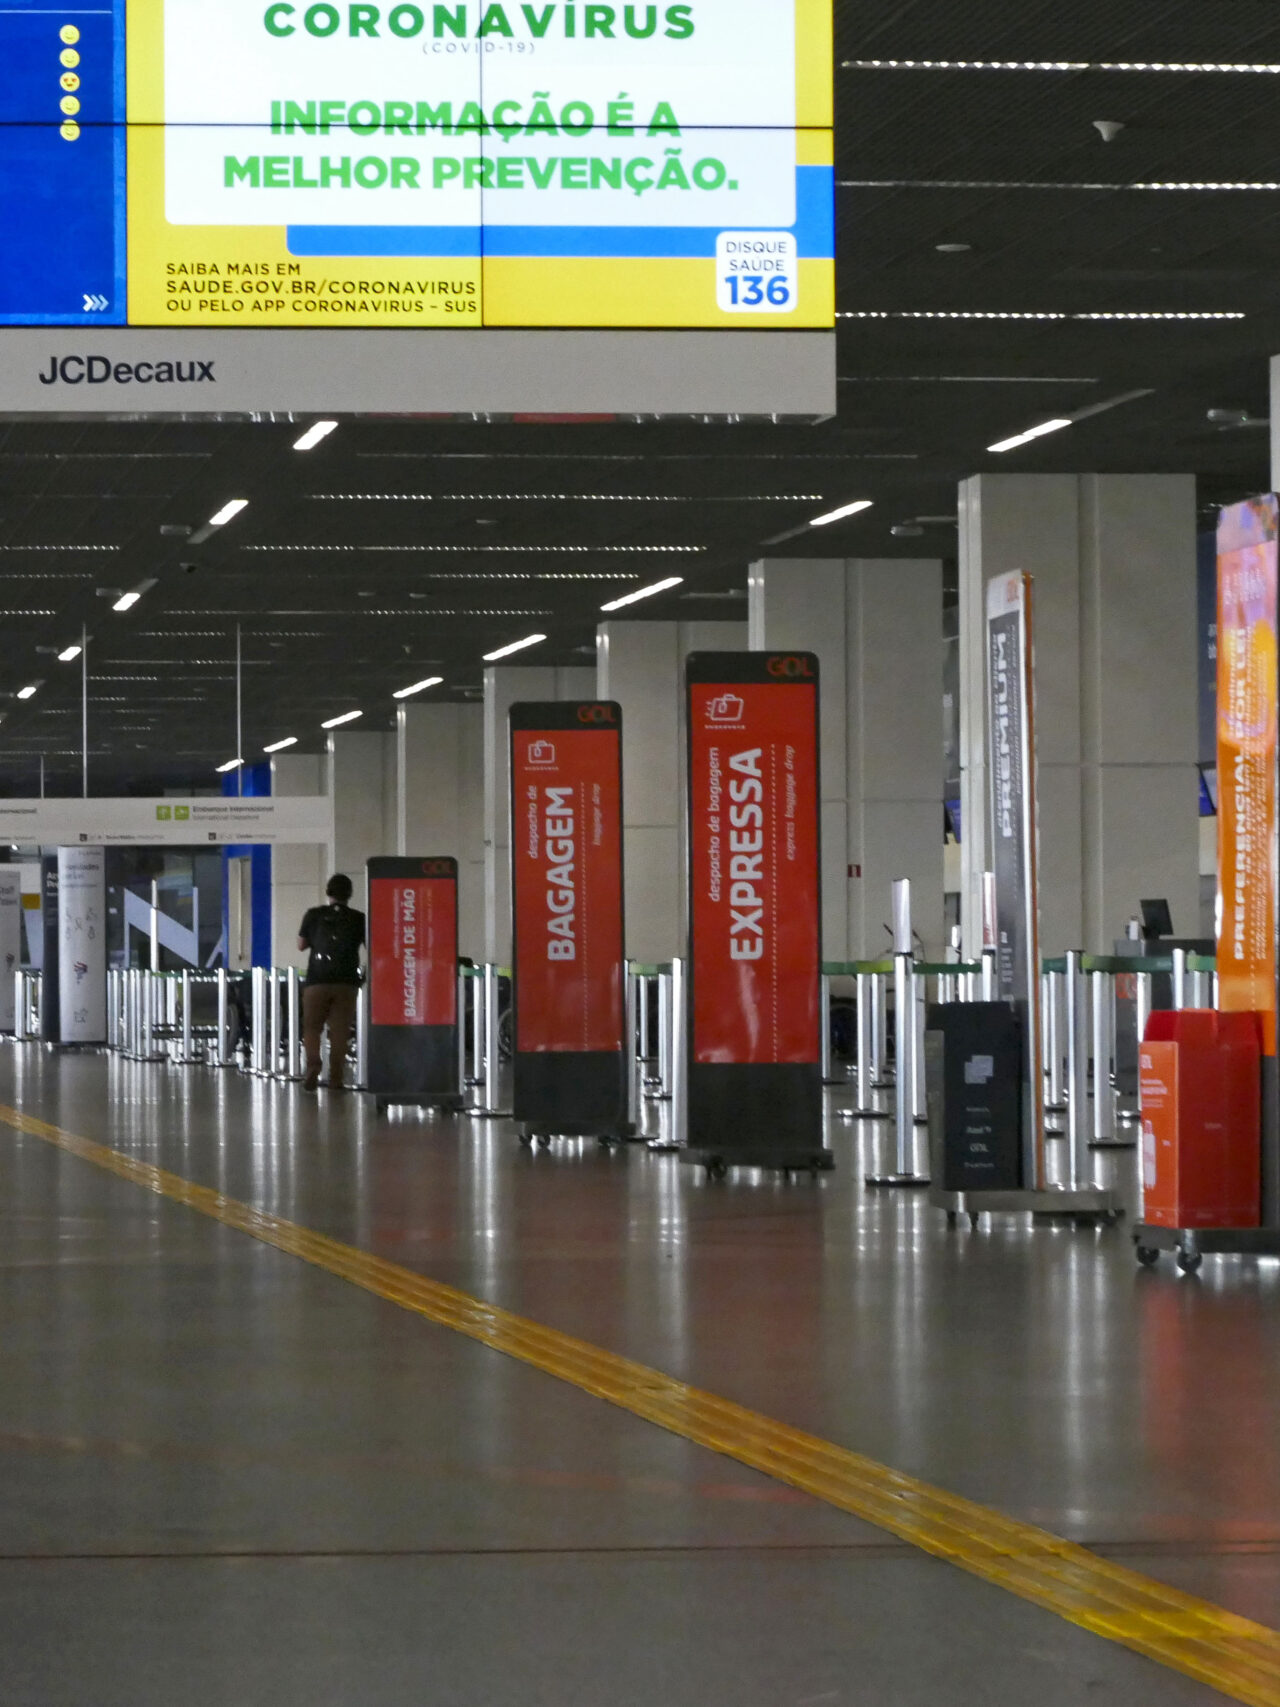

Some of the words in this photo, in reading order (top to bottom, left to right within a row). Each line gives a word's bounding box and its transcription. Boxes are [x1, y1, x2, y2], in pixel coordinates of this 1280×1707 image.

[263, 0, 696, 39] CORONAVÍRUS
[422, 41, 536, 55] (COVID-19)
[270, 91, 595, 143] INFORMAÇÃO
[609, 92, 634, 137] É
[646, 102, 682, 137] A
[224, 156, 420, 190] MELHOR
[433, 148, 738, 197] PREVENÇÃO.
[726, 240, 787, 254] DISQUE
[729, 254, 784, 272] SAÚDE
[165, 262, 222, 276] SAIBA
[227, 262, 270, 276] MAIS
[276, 262, 301, 276] EM
[165, 278, 477, 298] SAUDE.GOV.BR/CORONAVIRUS
[724, 275, 789, 307] 136
[165, 299, 192, 313] OU
[198, 299, 245, 313] PELO
[251, 299, 286, 313] APP
[292, 299, 424, 313] CORONAVIRUS
[444, 299, 477, 313] SUS
[39, 356, 217, 385] JCDecaux
[1235, 629, 1246, 669] LEI
[766, 657, 814, 677] GOL
[577, 705, 616, 723] GOL
[1235, 679, 1246, 739] POR
[997, 632, 1013, 838] PREMIUM
[784, 745, 797, 770] drop
[526, 785, 537, 801] de
[708, 747, 722, 812] bagagem
[527, 802, 540, 859] despacho
[708, 815, 721, 832] de
[728, 747, 763, 960] EXPRESSA
[784, 821, 796, 861] express
[1234, 754, 1246, 960] PREFERENCIAL
[545, 787, 575, 961] BAGAGEM
[708, 836, 722, 902] despacho
[400, 888, 415, 922] MÃO
[404, 925, 416, 944] DE
[404, 948, 417, 1017] BAGAGEM
